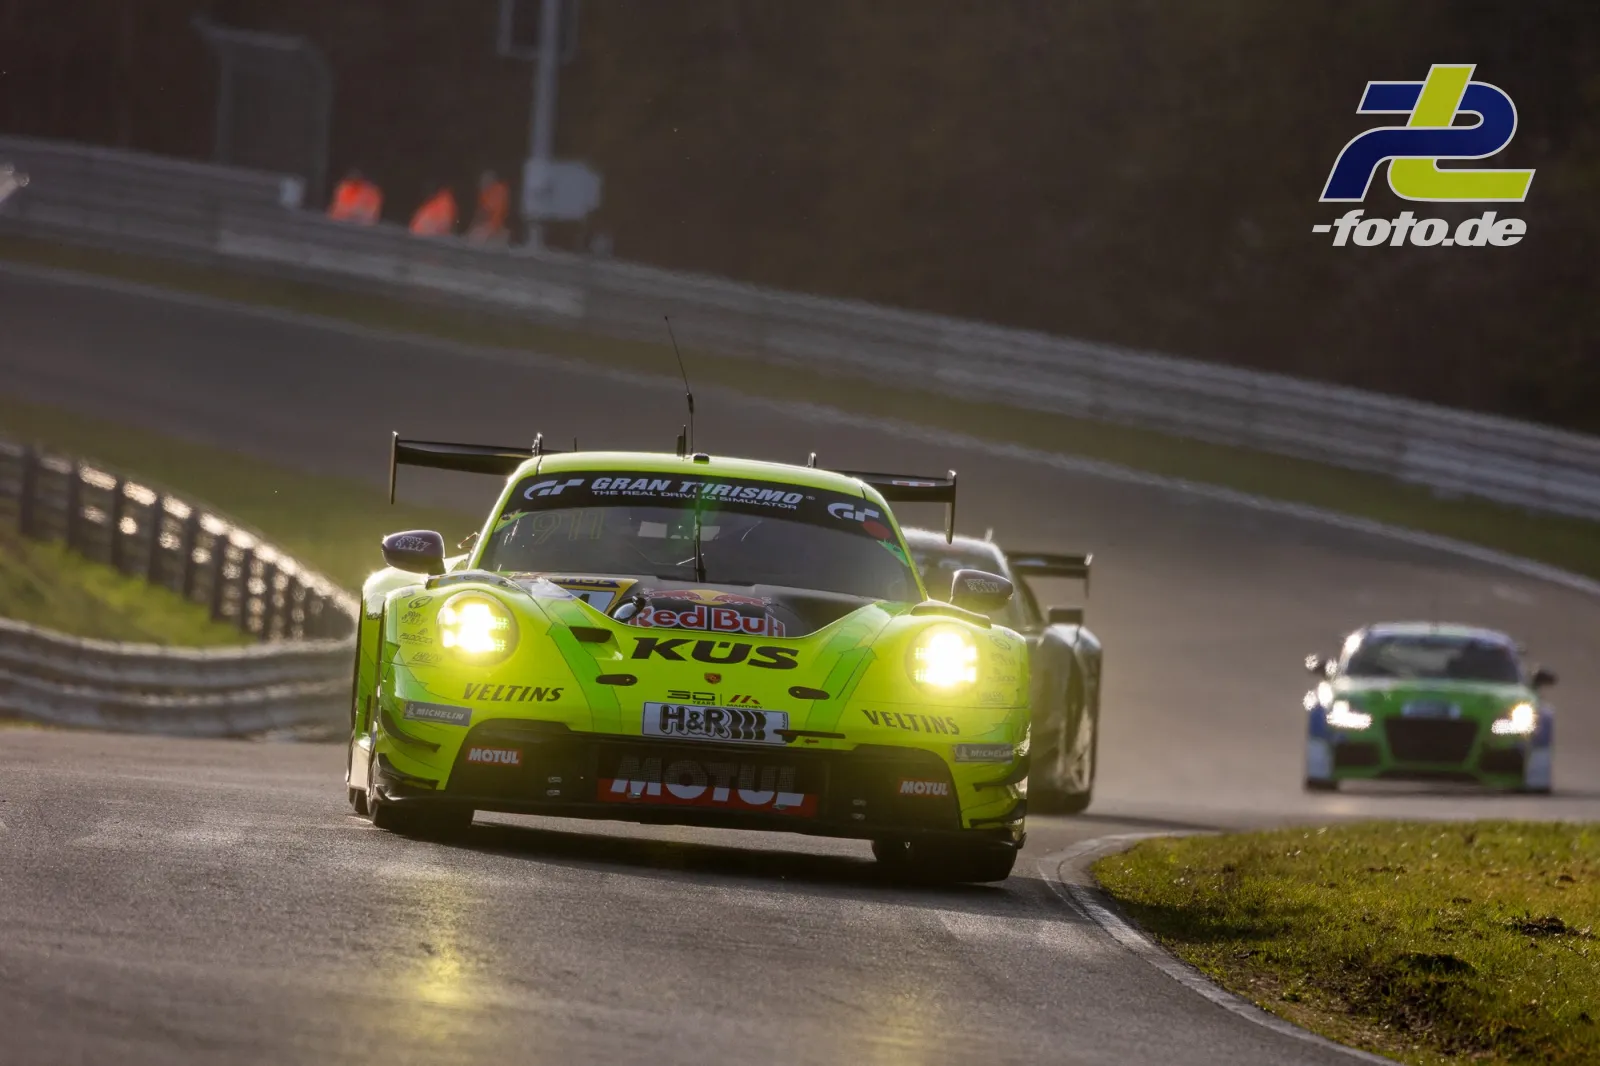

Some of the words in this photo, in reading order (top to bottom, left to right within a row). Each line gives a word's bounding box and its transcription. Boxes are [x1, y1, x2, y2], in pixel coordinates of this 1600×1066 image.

[591, 477, 672, 491] GRAN
[680, 480, 804, 505] TURISMO
[719, 496, 798, 510] SIMULATOR
[532, 509, 606, 545] 911
[629, 604, 707, 630] Red
[711, 607, 786, 638] Bull
[631, 637, 800, 670] KÜS
[463, 682, 563, 703] VELTINS
[667, 689, 716, 702] 30
[416, 707, 464, 722] MICHELIN
[660, 704, 731, 739] H&R
[862, 709, 960, 736] VELTINS
[467, 748, 520, 765] MOTUL
[610, 755, 805, 808] MOTUL
[900, 780, 948, 796] MOTUL
